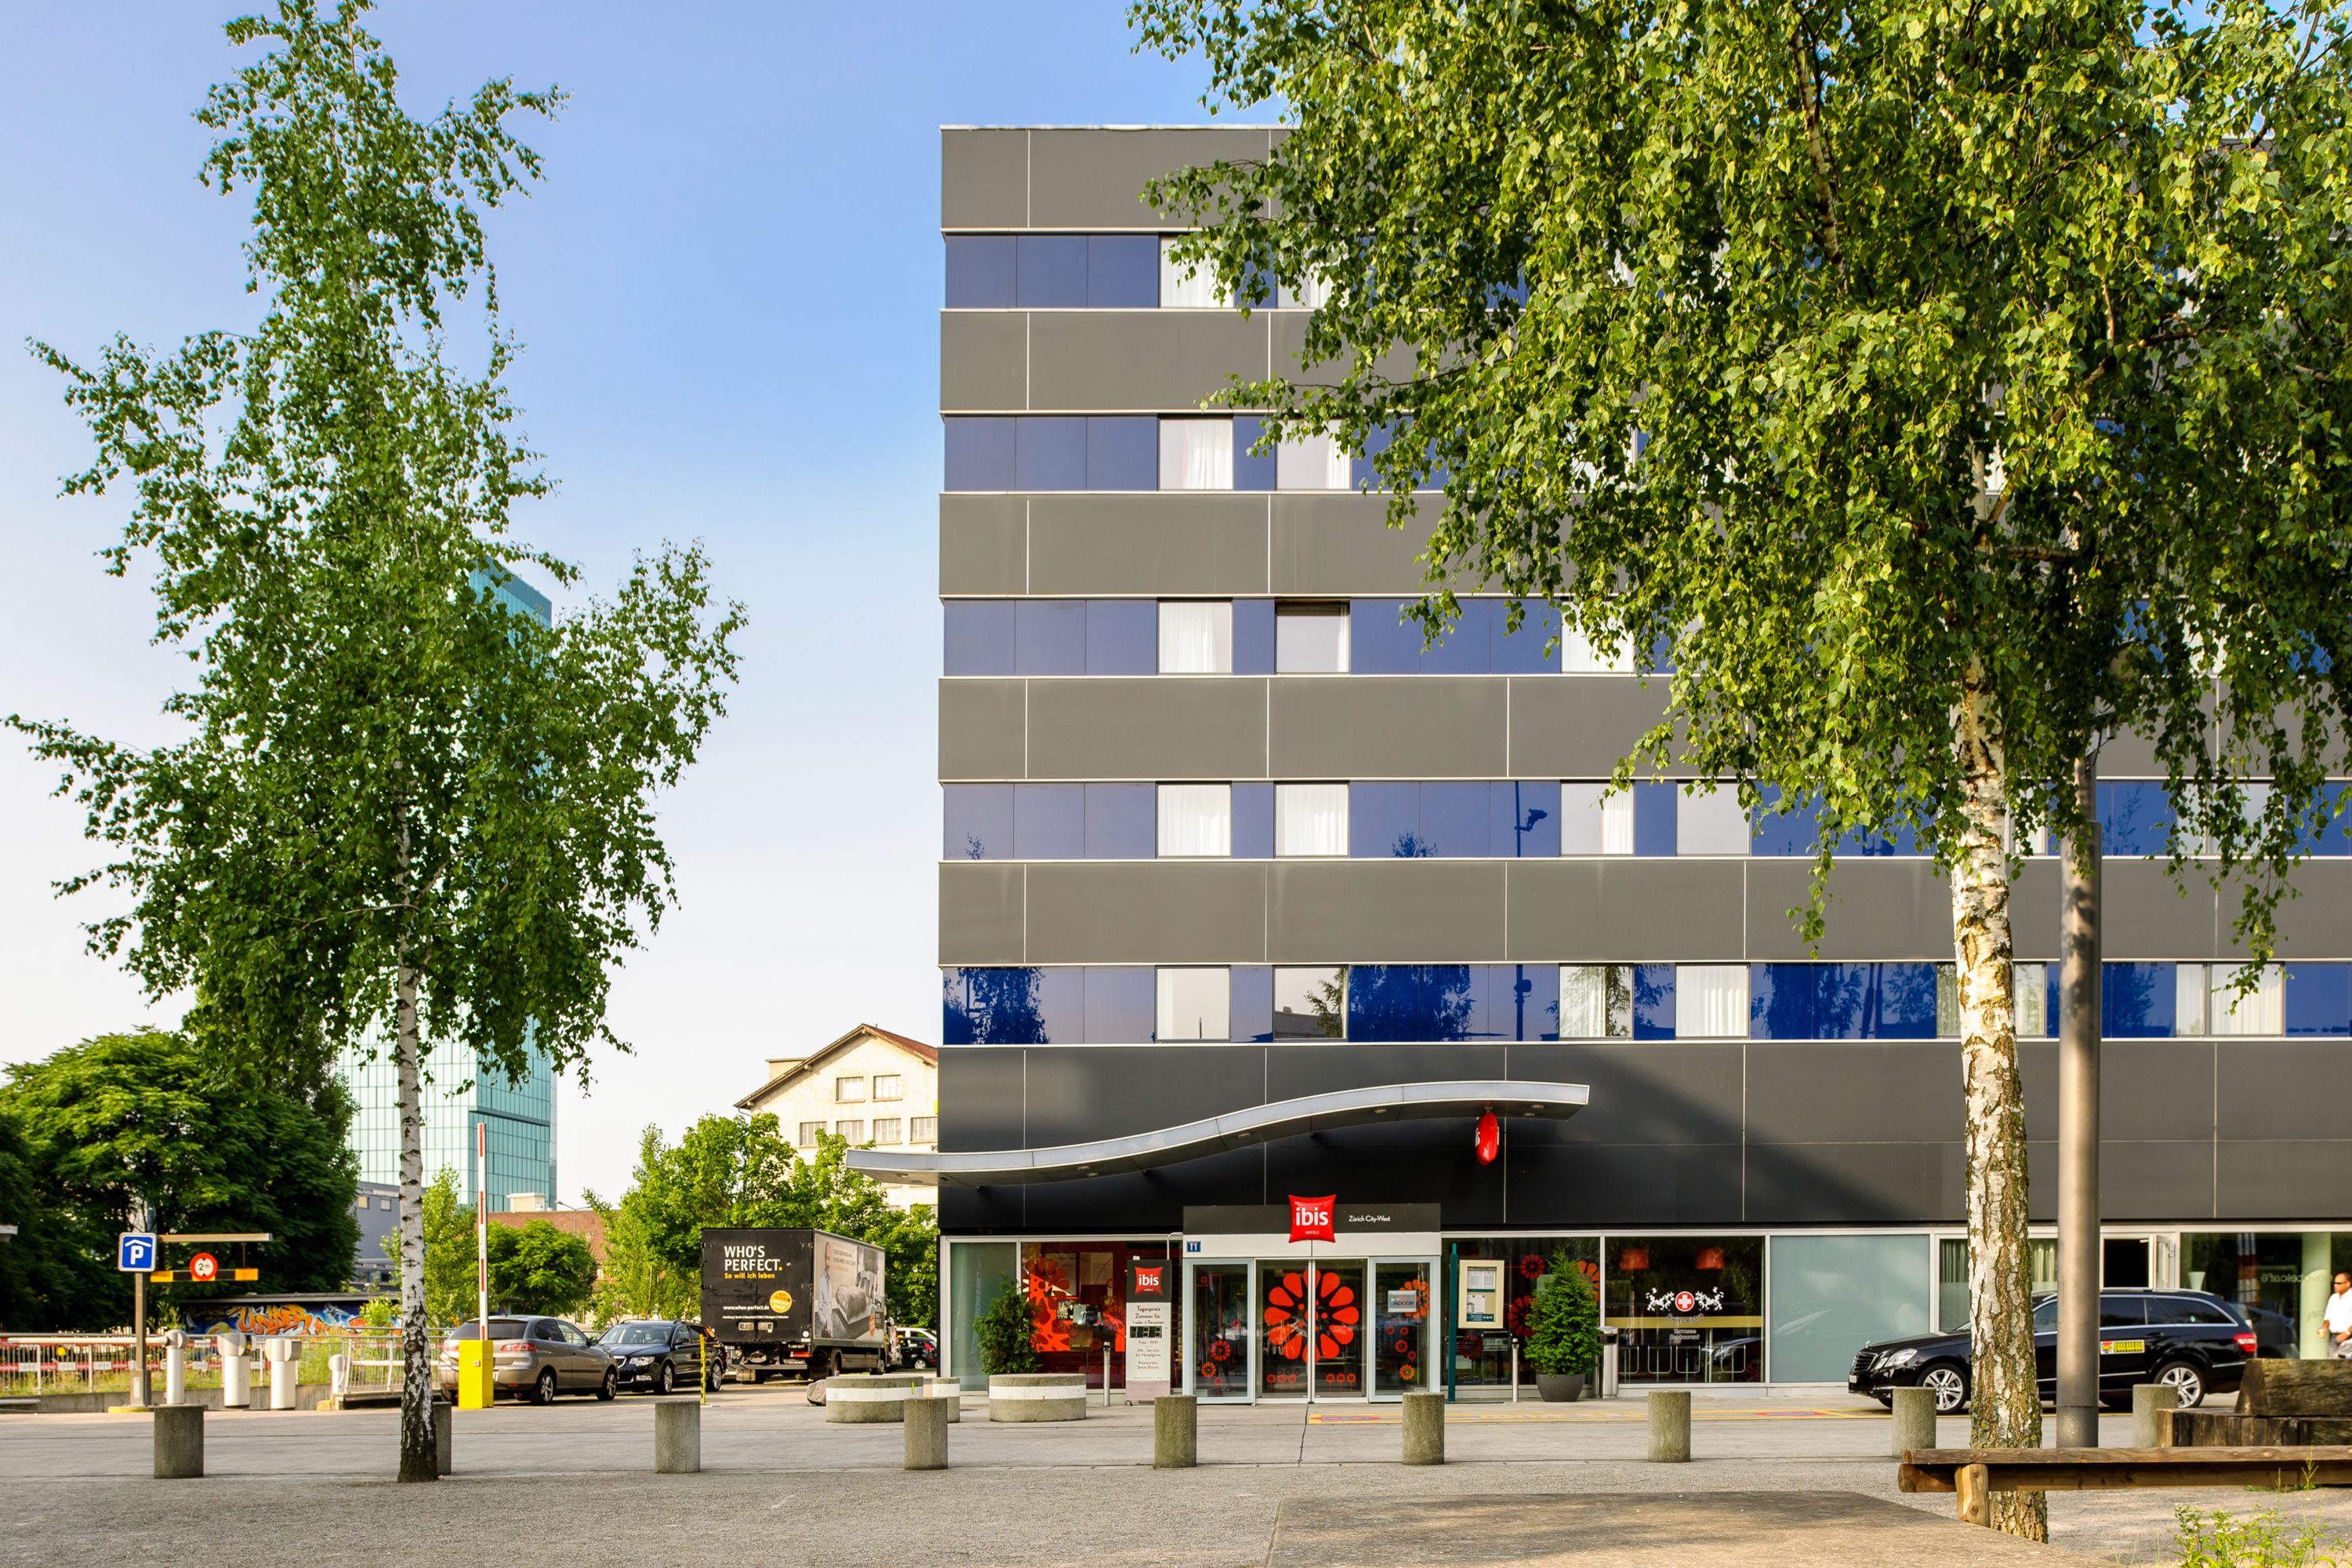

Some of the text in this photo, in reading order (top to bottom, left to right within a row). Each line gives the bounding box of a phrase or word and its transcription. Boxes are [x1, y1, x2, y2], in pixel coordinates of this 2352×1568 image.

[1296, 1207, 1329, 1226] ibis
[724, 1245, 765, 1258] WHO'S
[1189, 1243, 1197, 1251] 11
[130, 1245, 143, 1265] P
[724, 1258, 782, 1272] PERFECT.
[1138, 1274, 1160, 1286] ibis
[1667, 1312, 1704, 1324] Swiss Bistro
